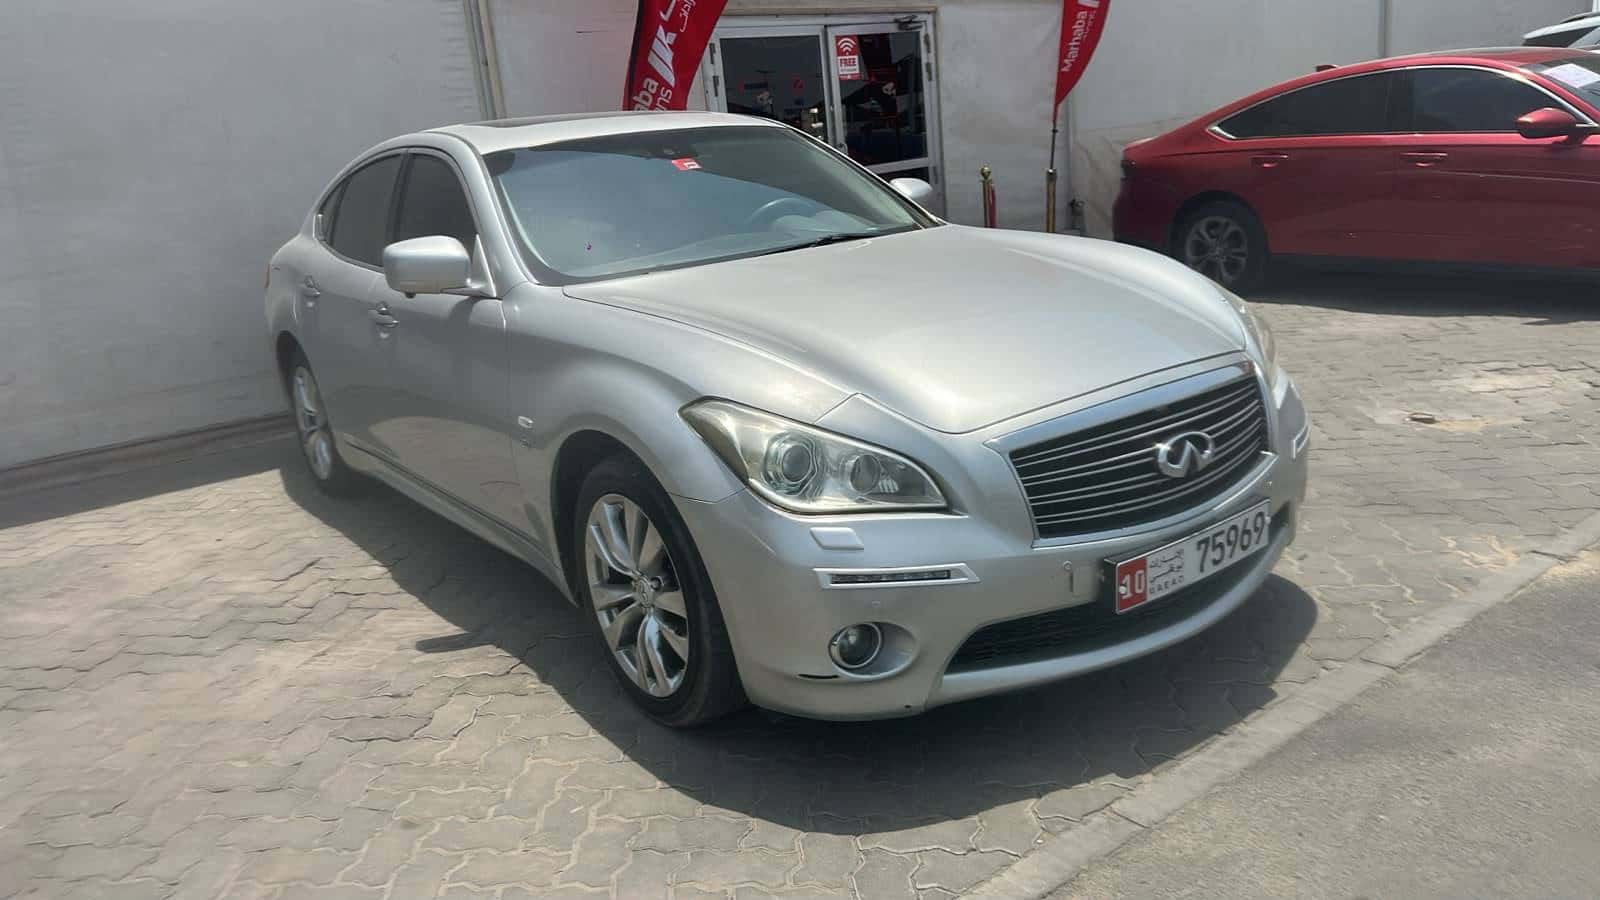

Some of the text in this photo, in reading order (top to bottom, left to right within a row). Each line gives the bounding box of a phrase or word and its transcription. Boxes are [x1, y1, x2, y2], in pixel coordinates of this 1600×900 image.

[839, 57, 857, 67] FREE
[1061, 11, 1088, 72] Marhaba
[1196, 511, 1266, 573] 75969
[1120, 569, 1146, 600] 10
